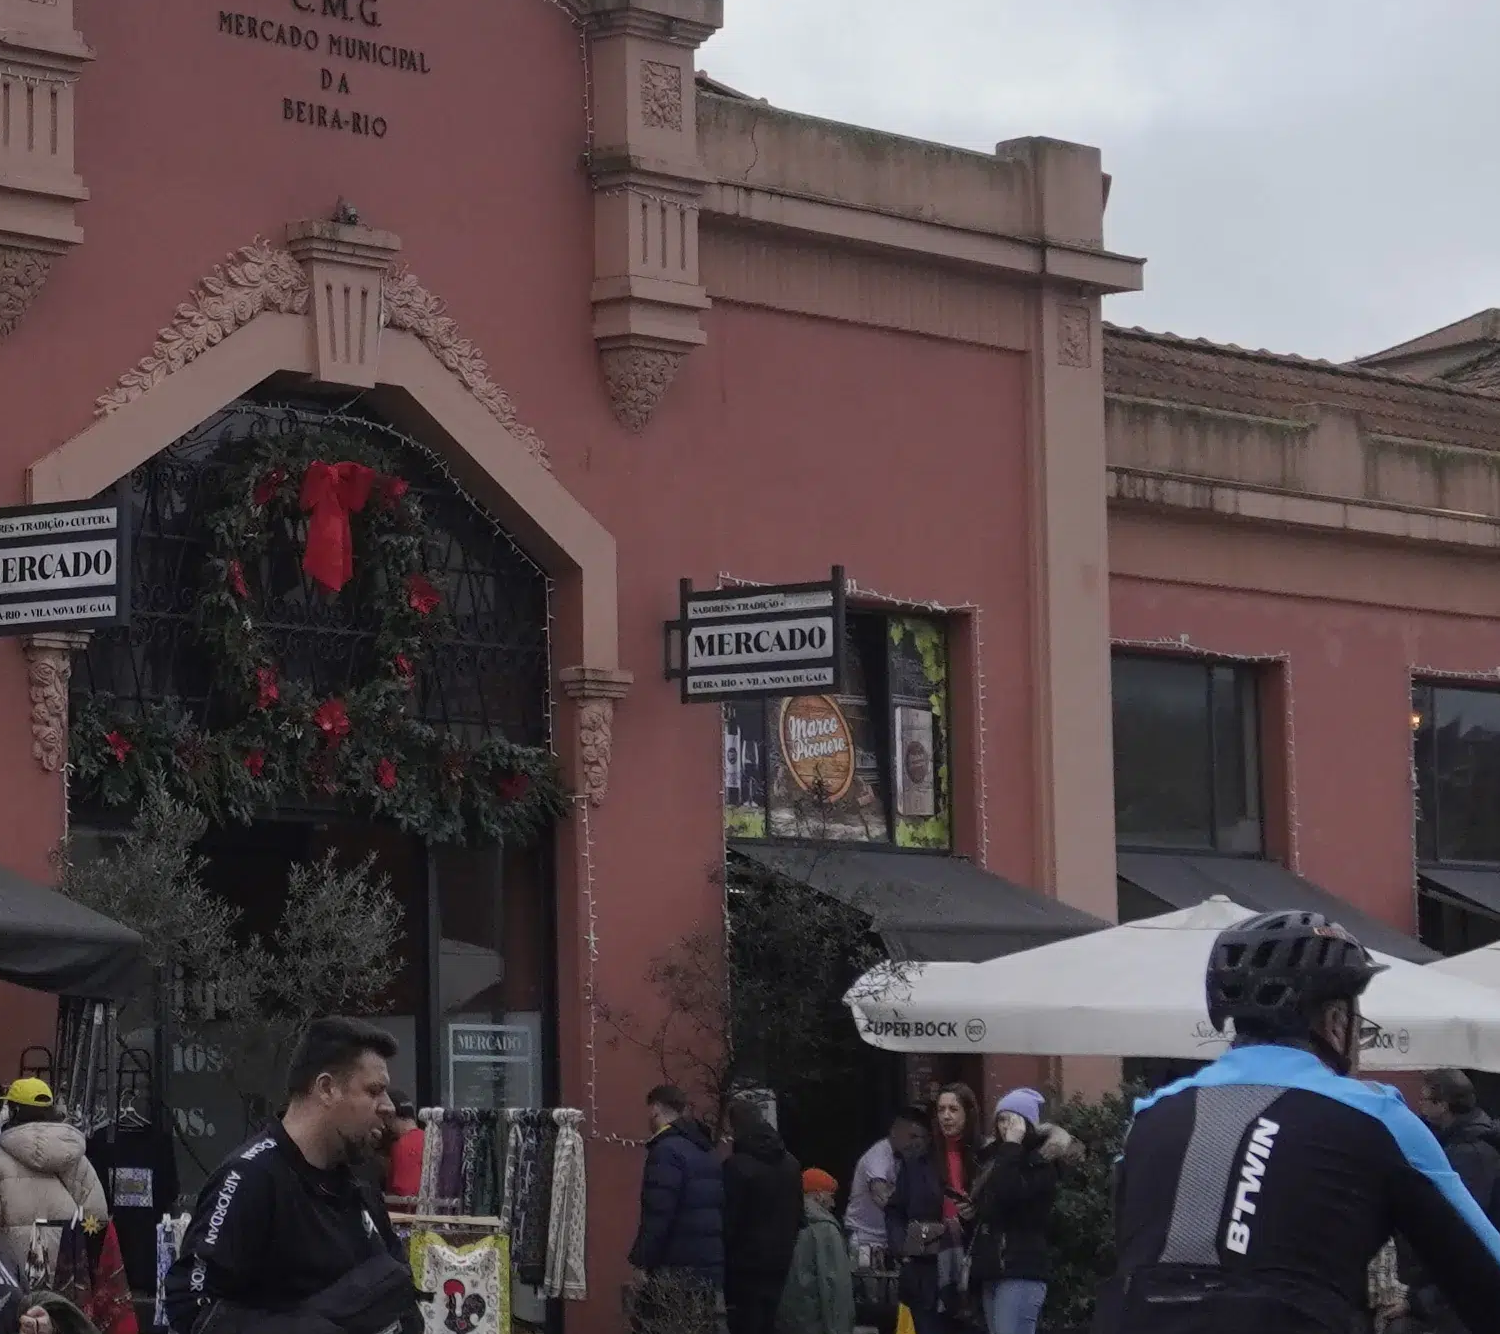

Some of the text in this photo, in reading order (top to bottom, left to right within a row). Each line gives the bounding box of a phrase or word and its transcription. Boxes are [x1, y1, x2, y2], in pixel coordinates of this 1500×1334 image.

[218, 10, 431, 74] MERCADO MUNICIPAL
[320, 67, 351, 95] DA
[281, 97, 388, 139] BEIRA-RIO
[20, 517, 64, 531] TRADIÇÃO
[70, 515, 111, 527] CULTURA
[30, 608, 51, 618] VILA
[52, 606, 75, 616] NOVA
[76, 603, 88, 614] DE
[692, 598, 780, 614] SABORES TRADIÇÃO
[694, 626, 827, 657] MERCADO
[746, 677, 767, 686] VILA
[769, 675, 791, 685] NOVA
[792, 674, 804, 683] DE
[788, 716, 839, 740] Marco
[914, 1021, 959, 1037] BOCK
